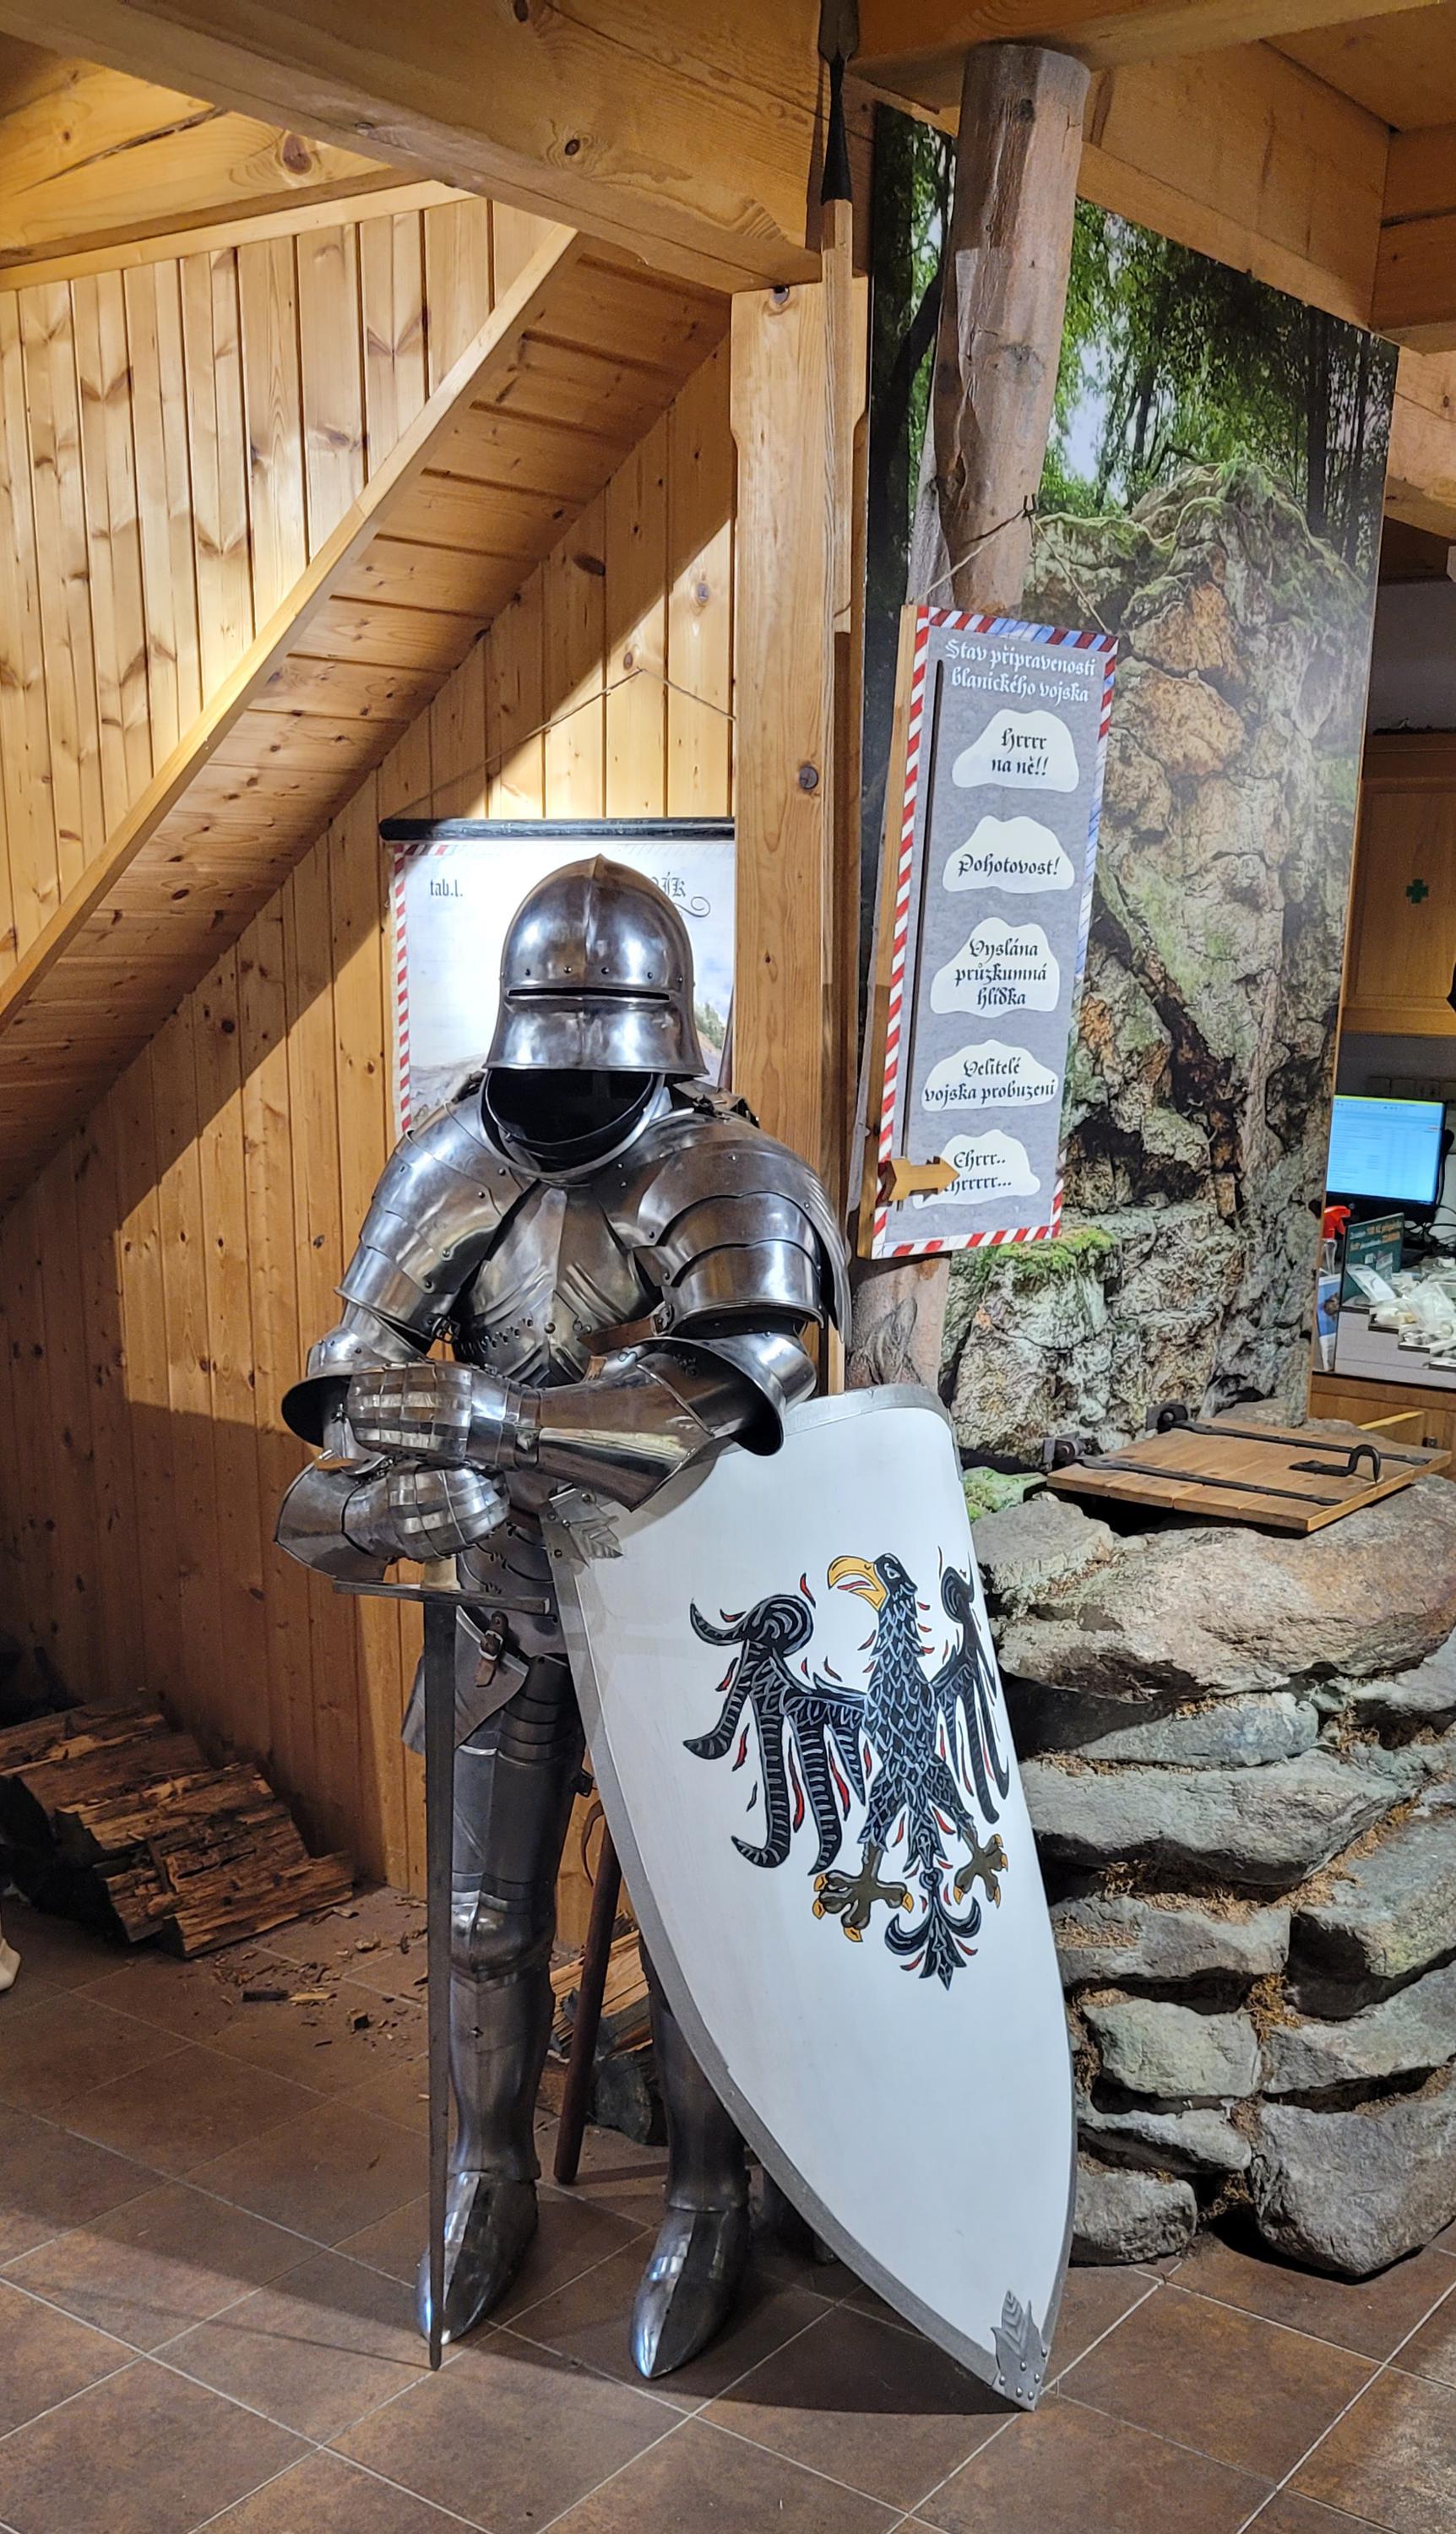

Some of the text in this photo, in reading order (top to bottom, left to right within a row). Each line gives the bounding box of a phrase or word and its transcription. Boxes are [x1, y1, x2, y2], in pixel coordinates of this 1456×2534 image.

[945, 638, 1096, 677] Stav připravenosti
[951, 666, 1089, 706] blanického vojska
[991, 759, 1011, 772] na
[958, 853, 1061, 878] Pohotovost!
[969, 938, 1039, 964] Vyslána
[954, 963, 1047, 987] průzkumná
[976, 987, 1026, 1010] hlídka
[963, 1057, 1021, 1078] Velitelé
[925, 1079, 1055, 1110] vojska probuzeni
